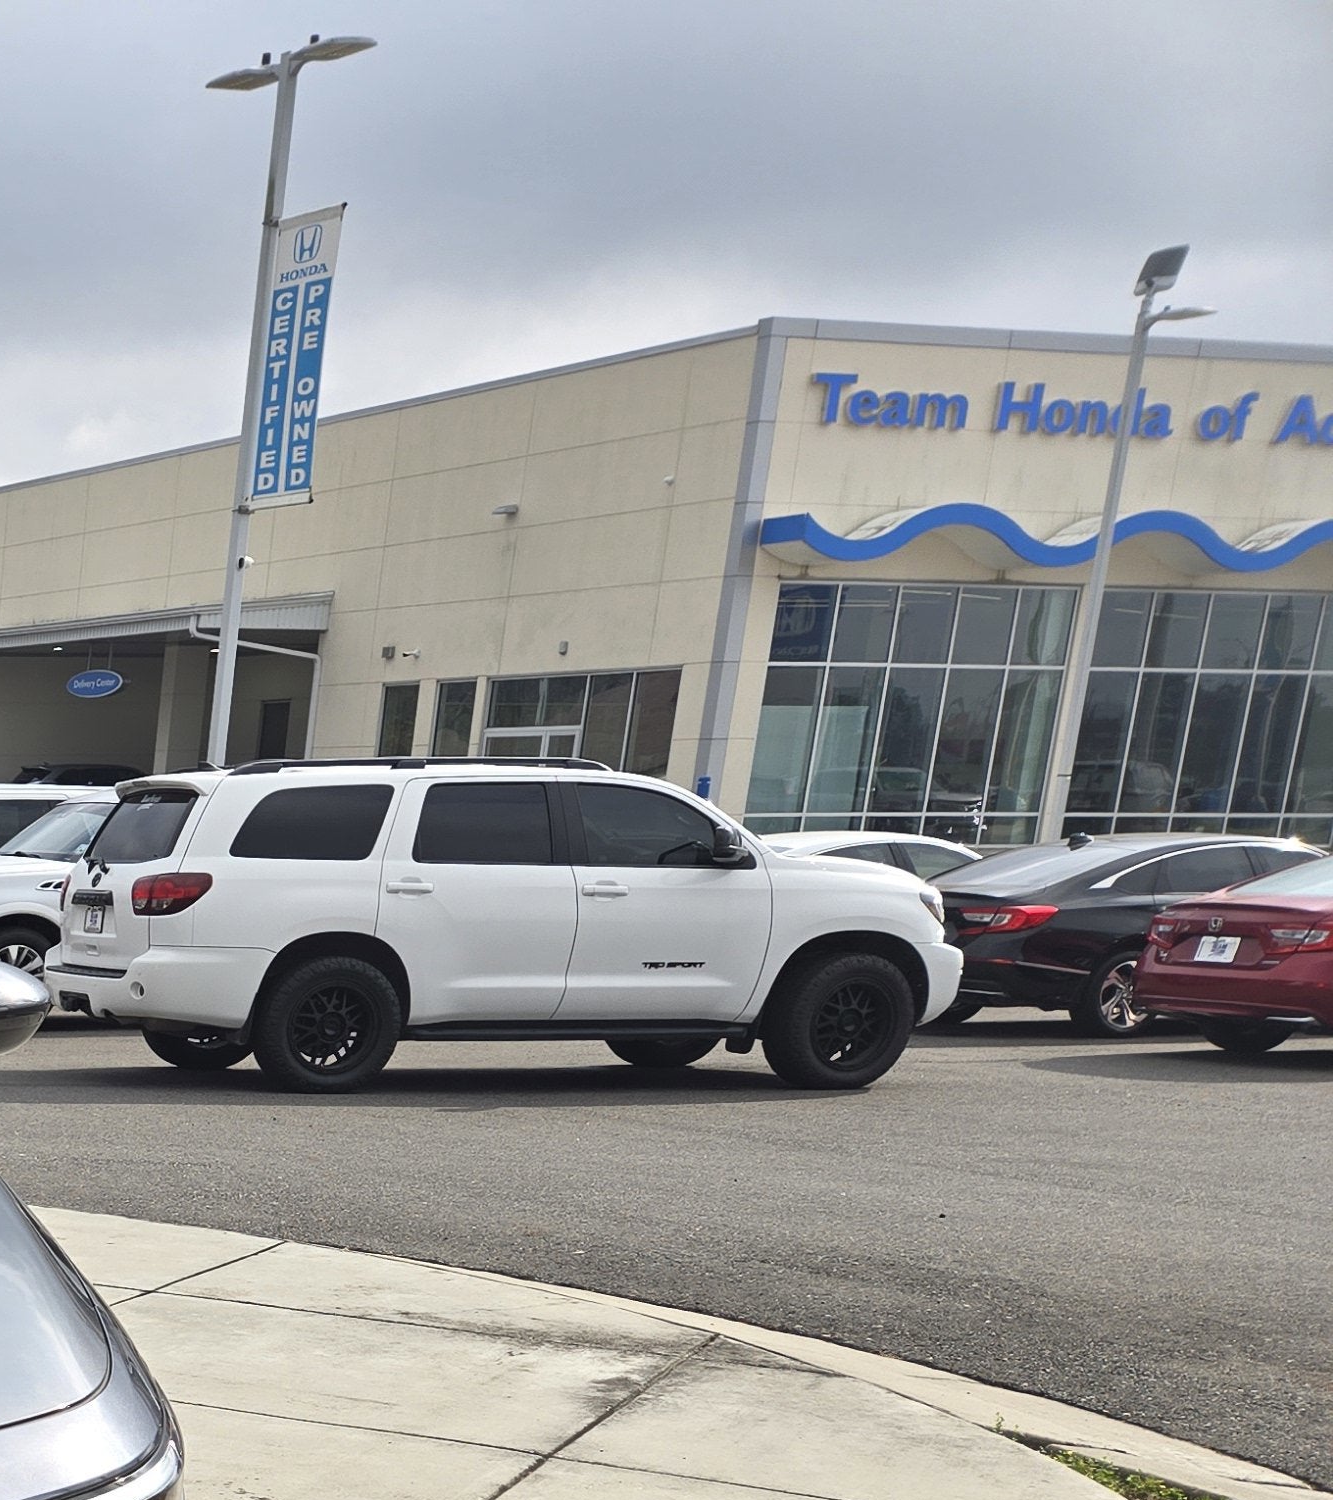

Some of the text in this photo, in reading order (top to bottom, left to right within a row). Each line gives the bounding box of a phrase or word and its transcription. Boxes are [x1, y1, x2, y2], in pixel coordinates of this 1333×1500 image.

[279, 263, 328, 283] HONDA
[256, 292, 293, 491] CERTIFIED
[289, 284, 325, 487] PRE OWNED
[813, 371, 969, 430] Team
[993, 381, 1173, 439] Honda
[1197, 390, 1261, 442] of
[73, 678, 116, 690] Delivery Center
[666, 961, 706, 969] SPORT
